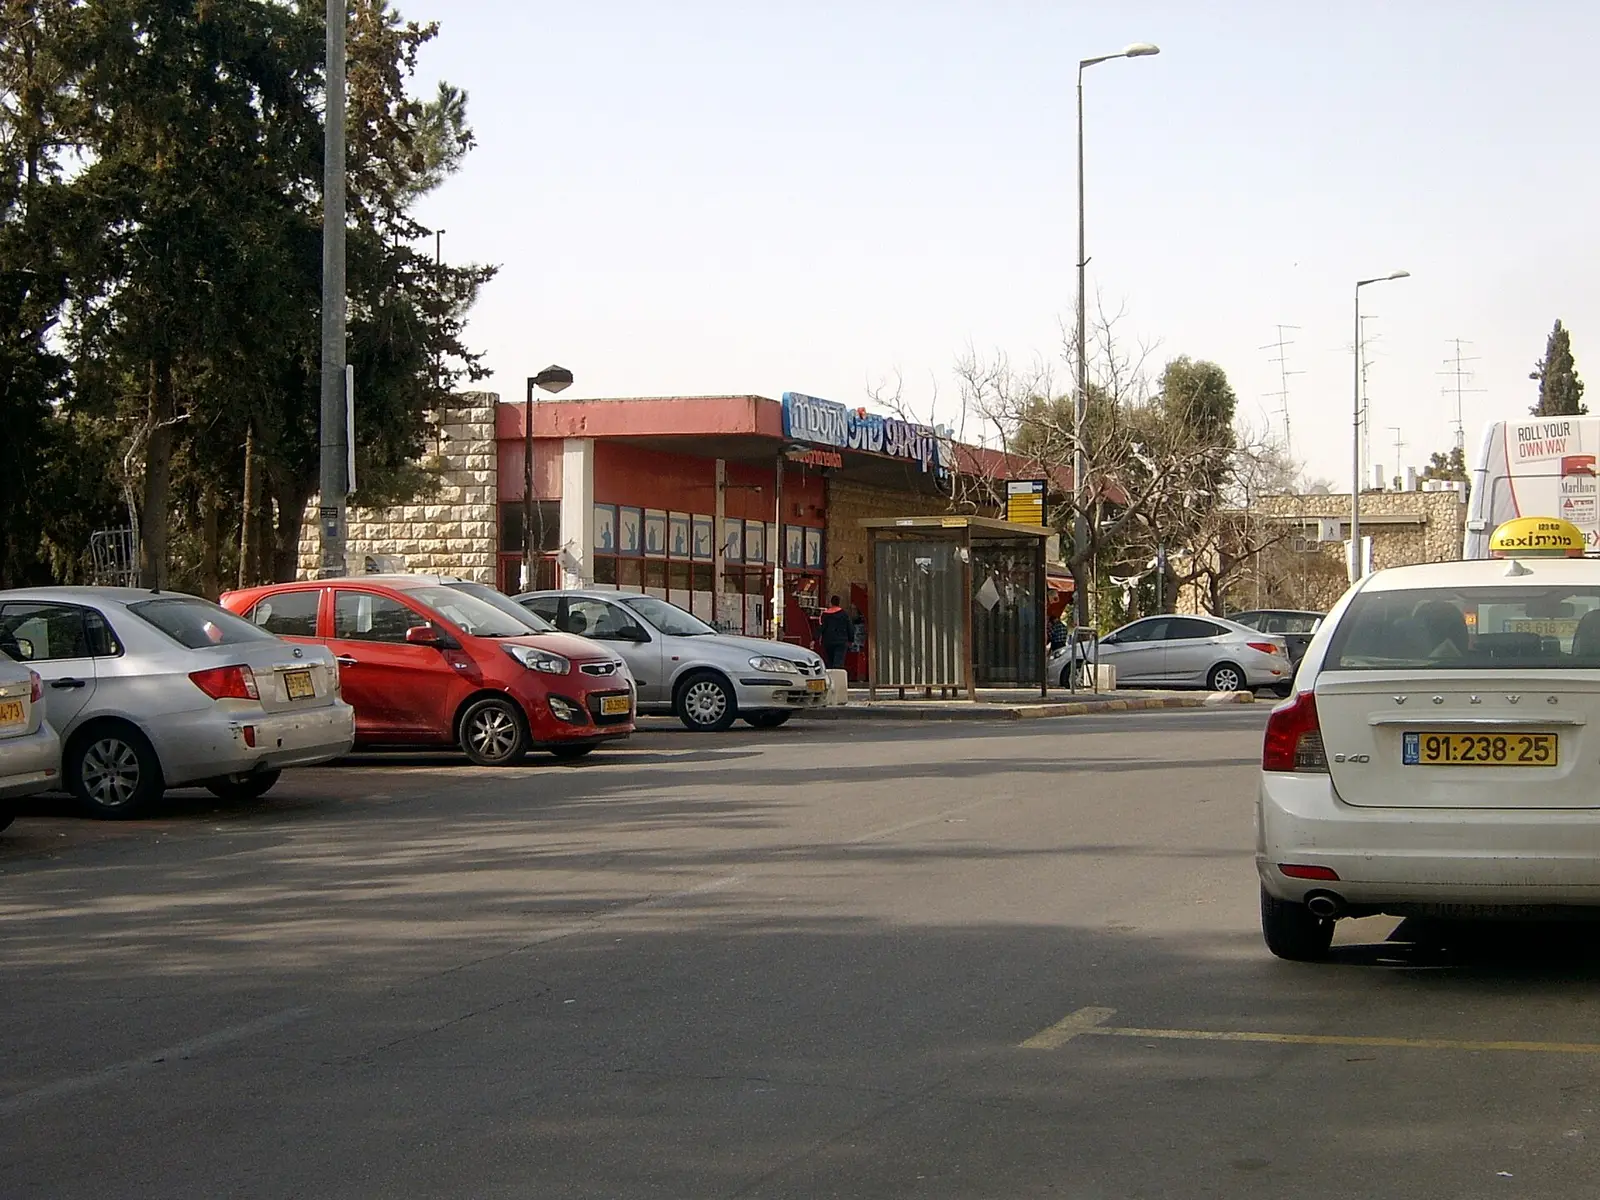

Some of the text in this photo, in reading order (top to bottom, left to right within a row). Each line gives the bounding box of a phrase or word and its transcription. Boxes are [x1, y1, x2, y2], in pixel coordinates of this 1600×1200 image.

[1517, 421, 1571, 442] ROLL YOUR
[1519, 438, 1567, 458] OWN WAY
[1561, 478, 1596, 493] Marlboro
[1500, 531, 1572, 547] taxi מונית
[1393, 695, 1558, 705] VOLVO
